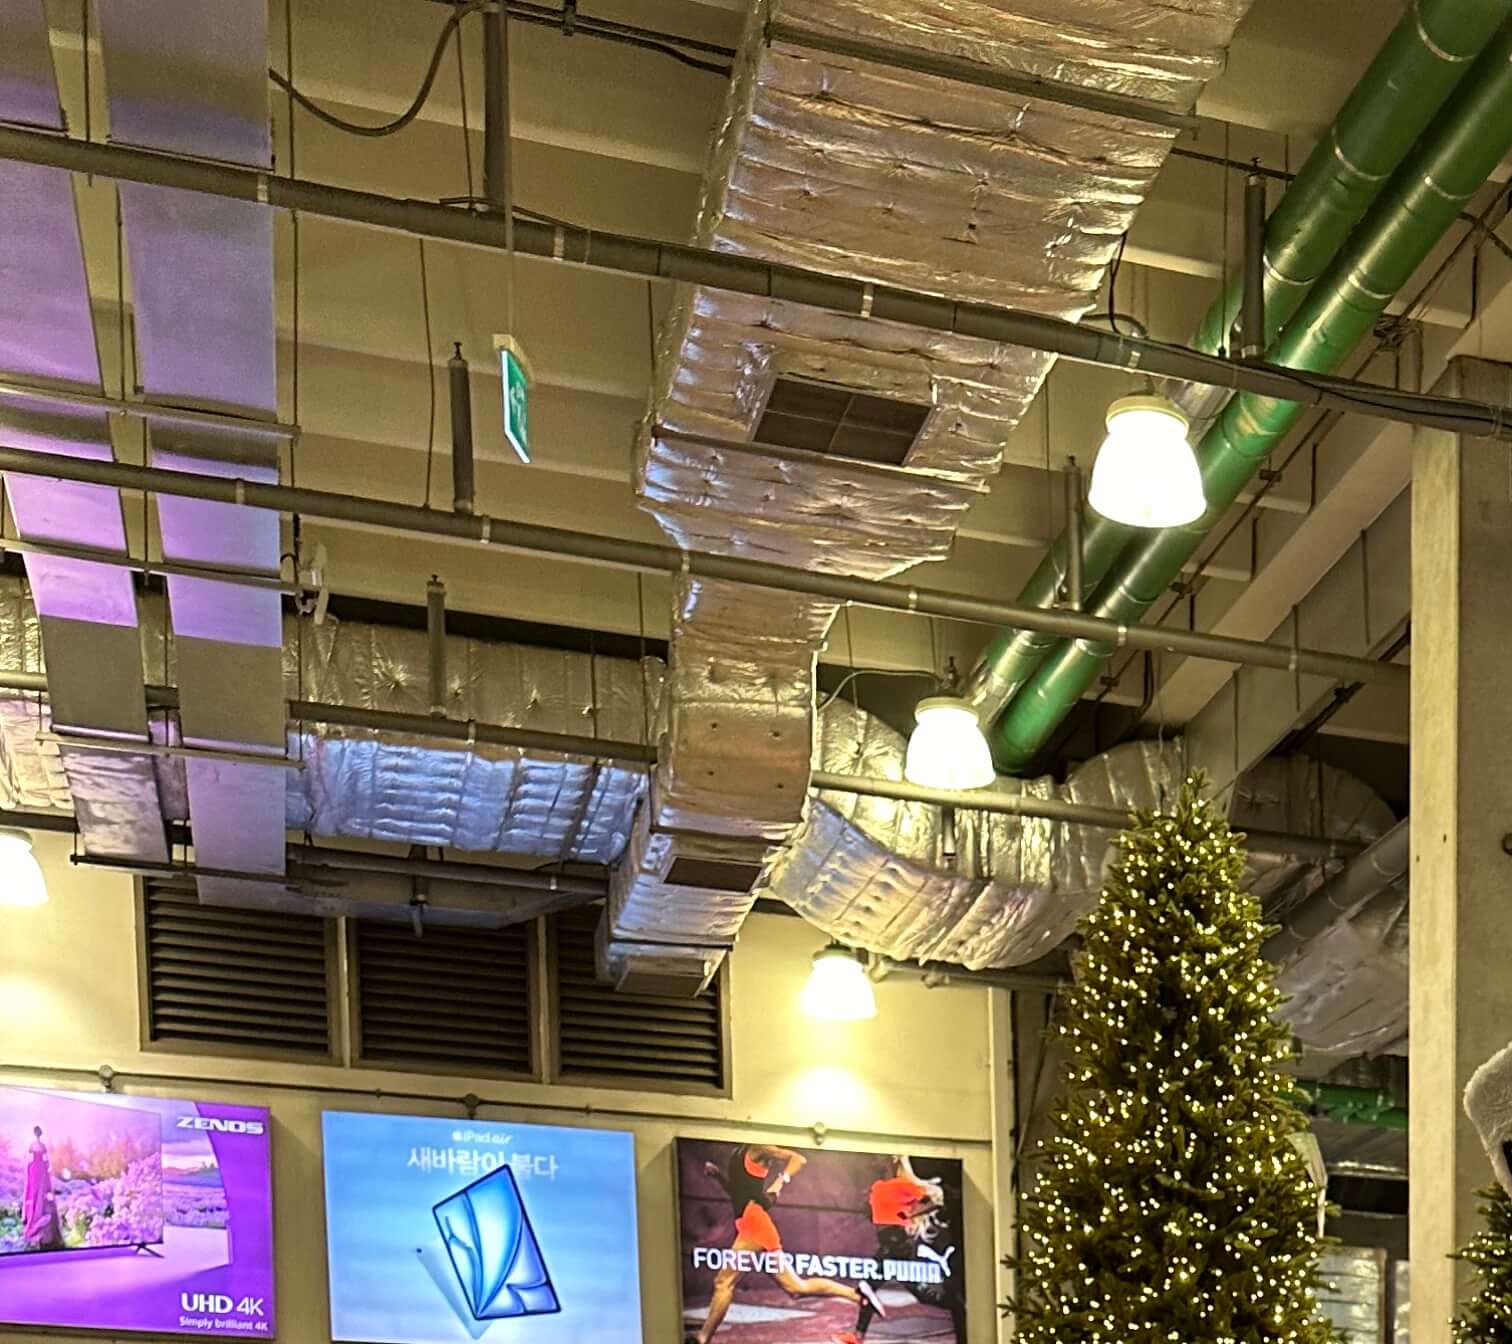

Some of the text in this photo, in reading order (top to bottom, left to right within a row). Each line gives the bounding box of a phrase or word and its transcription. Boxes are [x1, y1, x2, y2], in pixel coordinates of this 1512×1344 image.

[176, 1115, 264, 1136] ZENOS
[693, 1248, 942, 1284] FOREVER FASTER. PUMA
[180, 1292, 265, 1317] UHD 4K
[179, 1315, 213, 1330] Simply
